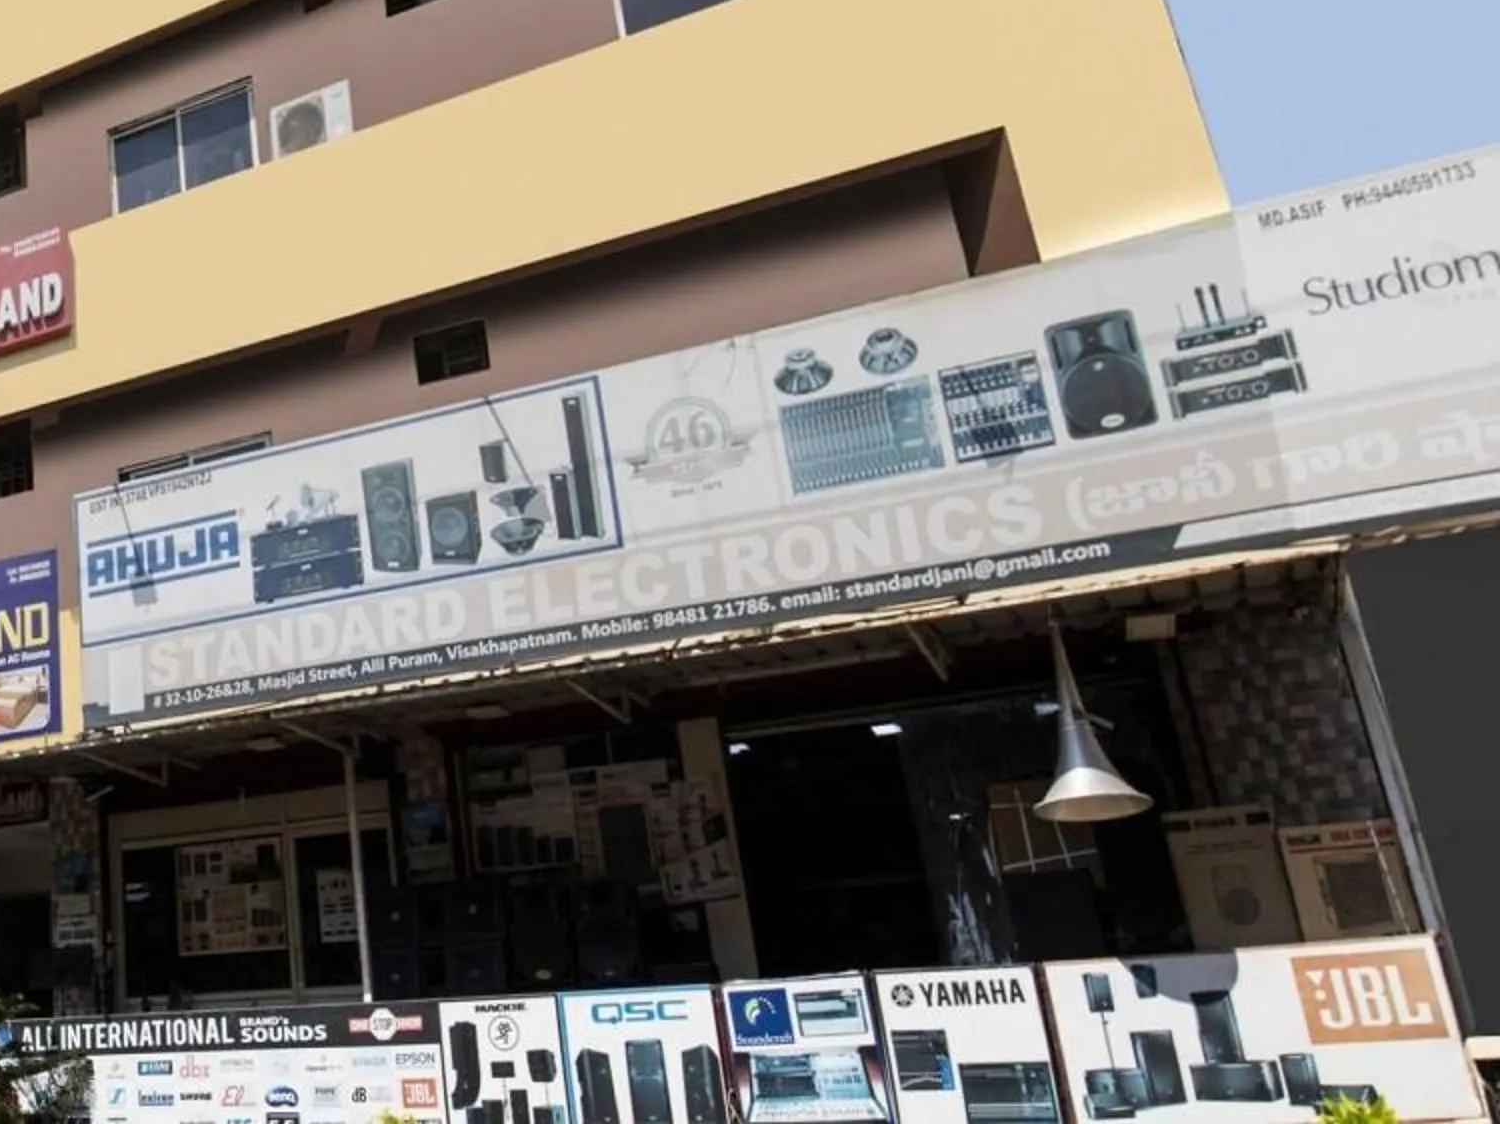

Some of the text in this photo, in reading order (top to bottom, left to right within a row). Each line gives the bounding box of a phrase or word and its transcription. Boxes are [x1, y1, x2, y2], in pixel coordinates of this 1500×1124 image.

[1258, 199, 1326, 228] MD.ASIF
[659, 410, 714, 454] 46
[87, 521, 240, 587] AHUJA
[149, 488, 1042, 687] STANDARD ELECTRONICS
[258, 669, 305, 694] Masjid
[308, 663, 357, 685] Street,
[360, 654, 385, 674] Alli
[388, 647, 443, 671] Puram,
[446, 628, 577, 661] Visakhapatnam.
[581, 618, 649, 642] Mobile:
[652, 606, 708, 630] 98481
[712, 596, 777, 622] 21786.
[780, 586, 841, 610] email:
[845, 540, 1112, 600] standardjani@gmail.com
[918, 978, 1026, 1007] YAMAHA
[1316, 963, 1433, 1029] JBL
[592, 999, 688, 1025] QSC
[60, 1016, 235, 1051] INTERNATIONAL
[240, 1024, 328, 1044] SOUNDS
[395, 1051, 436, 1065] EPSON
[404, 1083, 435, 1104] JBL
